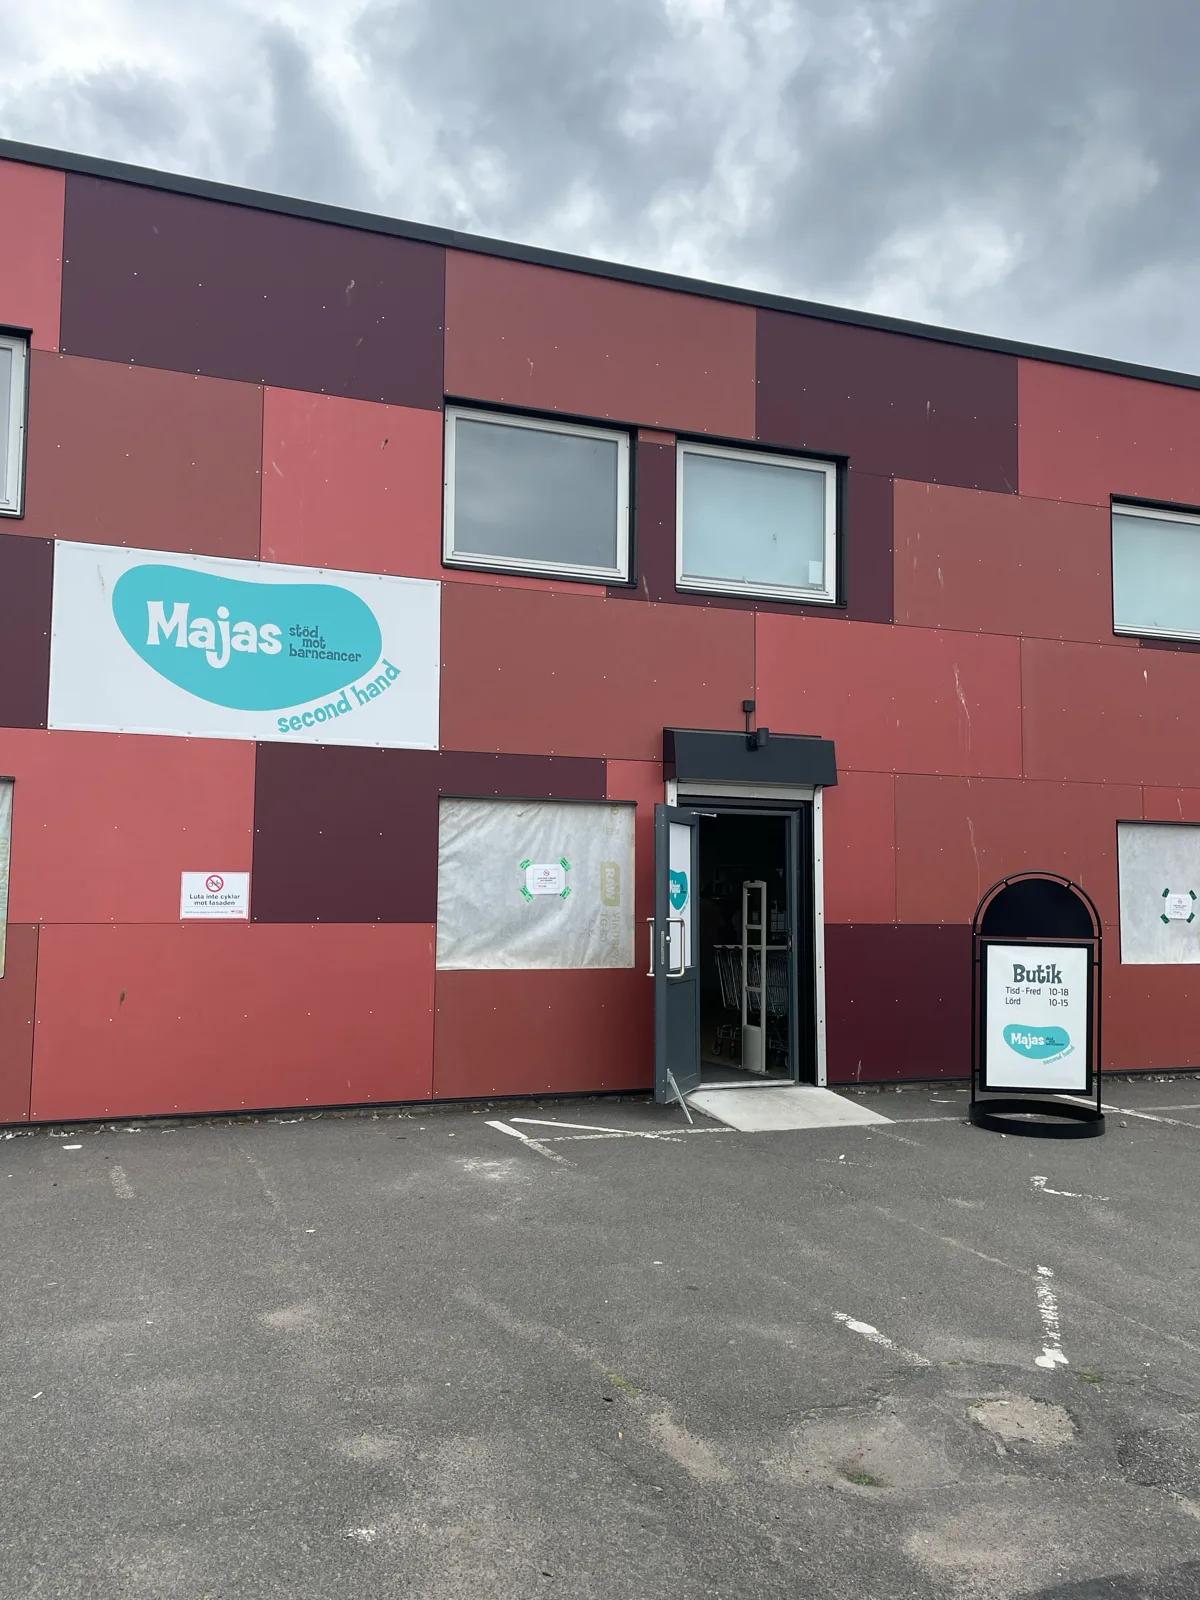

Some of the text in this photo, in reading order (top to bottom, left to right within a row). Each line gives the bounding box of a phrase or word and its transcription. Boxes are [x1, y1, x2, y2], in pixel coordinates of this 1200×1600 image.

[146, 600, 282, 669] Majas
[289, 624, 319, 639] stöd
[302, 637, 326, 650] mot
[289, 647, 362, 663] barncancer
[277, 658, 401, 733] second hand
[1013, 964, 1062, 984] Butik
[1005, 986, 1021, 995] Tisd
[1025, 987, 1041, 996] Fred
[1049, 987, 1069, 996] 10-18
[1005, 997, 1069, 1007] Lörd 10-15
[1011, 1032, 1045, 1049] Majas
